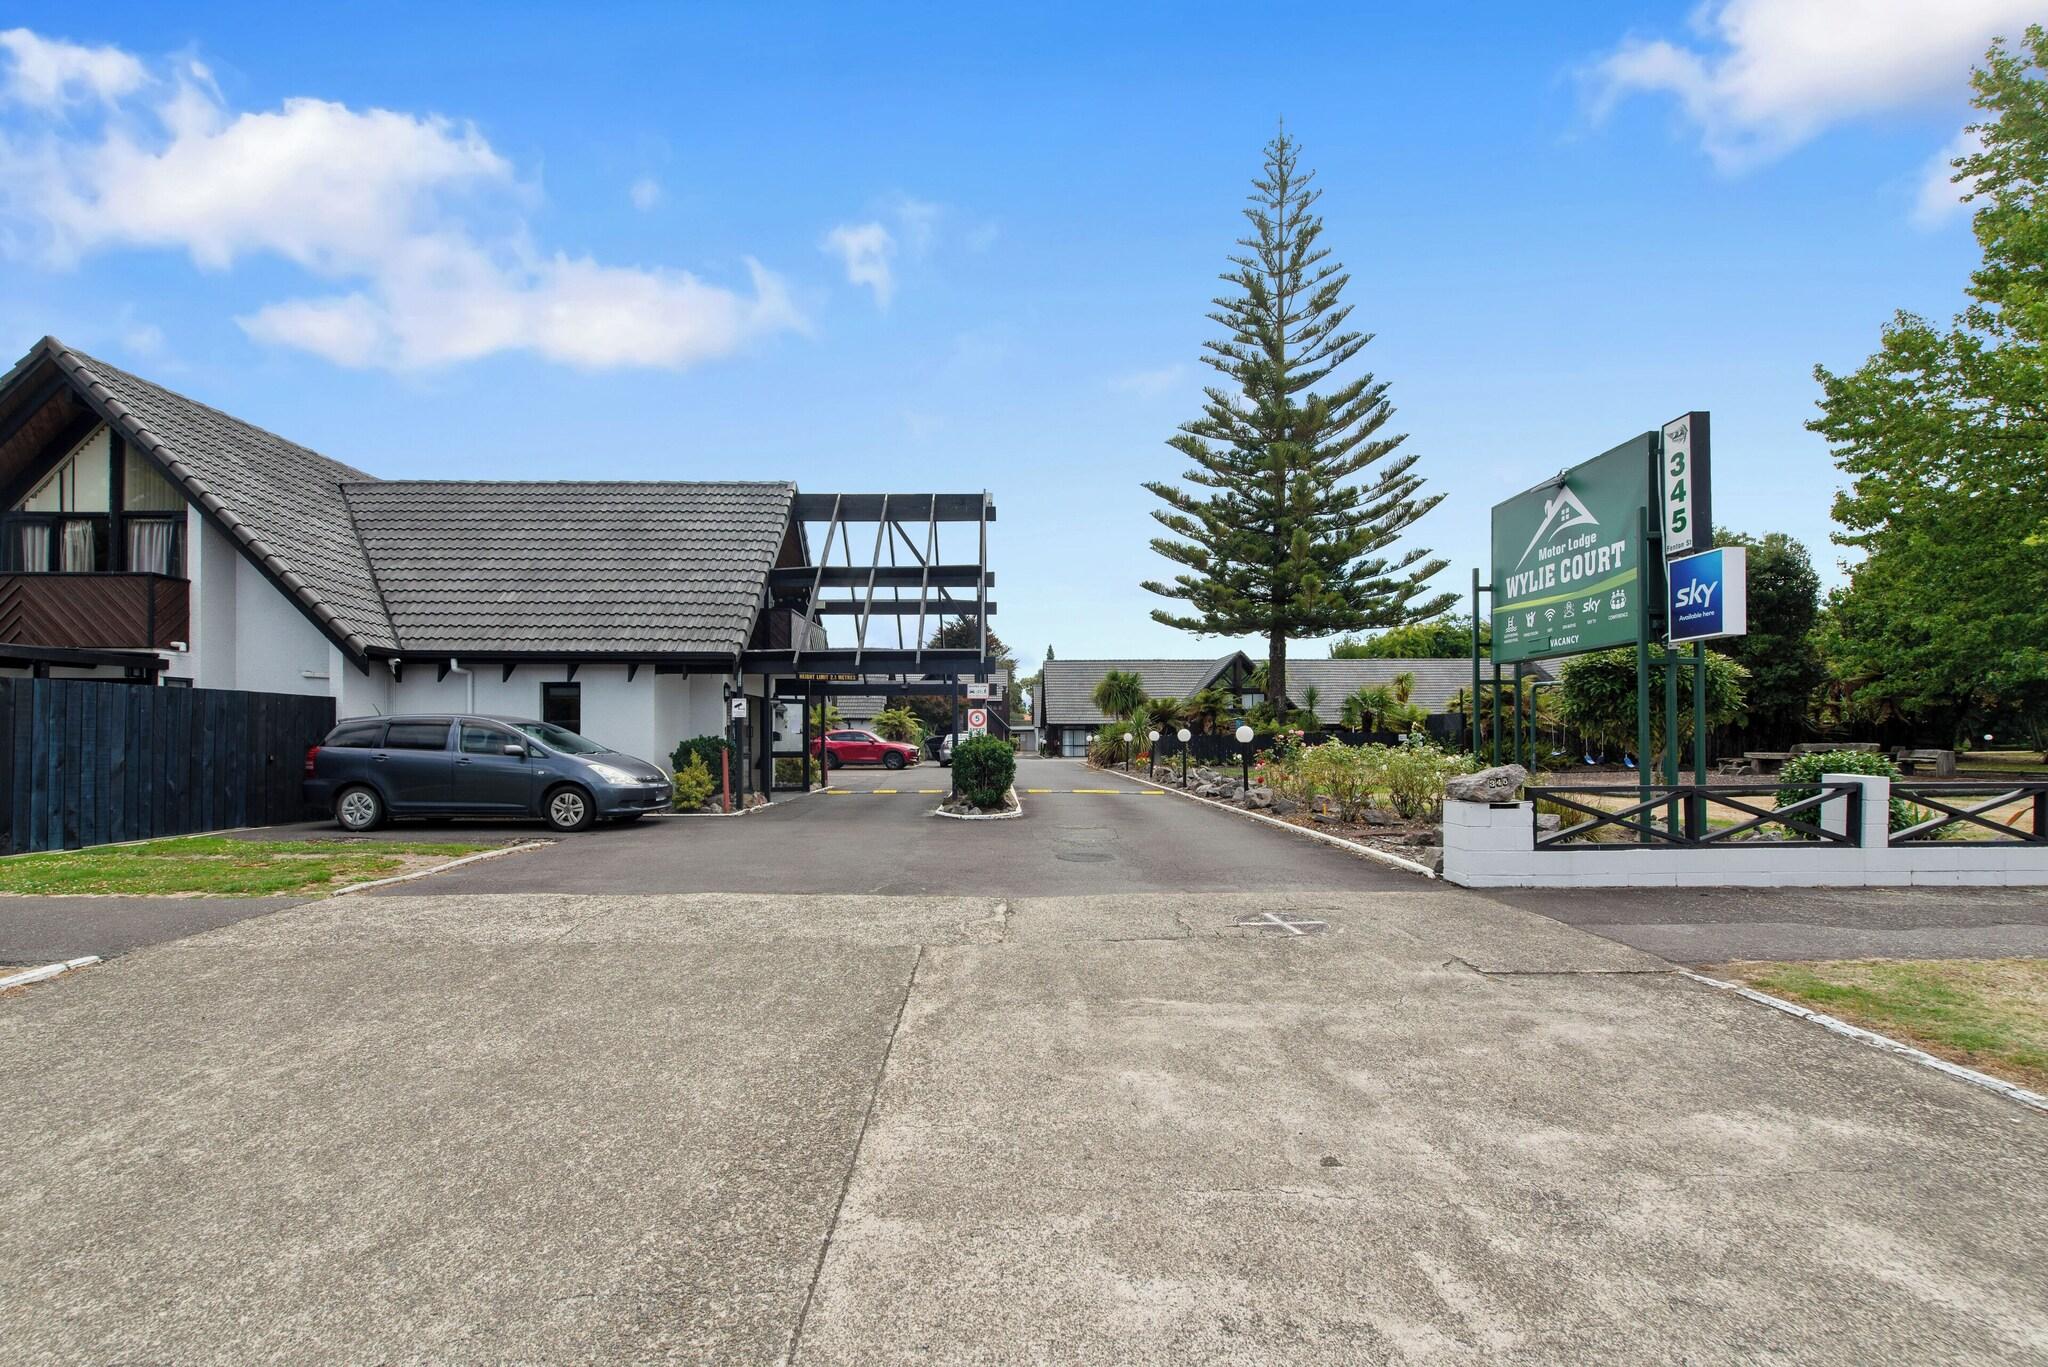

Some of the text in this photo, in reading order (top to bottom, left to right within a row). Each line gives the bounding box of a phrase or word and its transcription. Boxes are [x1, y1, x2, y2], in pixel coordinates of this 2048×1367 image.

[1670, 451, 1687, 533] 345
[1539, 533, 1597, 560] Motor Lodge
[1666, 542, 1684, 552] Fenton
[1505, 540, 1625, 599] WYLIE COURT
[1675, 578, 1719, 608] sky
[1679, 611, 1702, 622] Available
[1550, 635, 1579, 648] VACANCY
